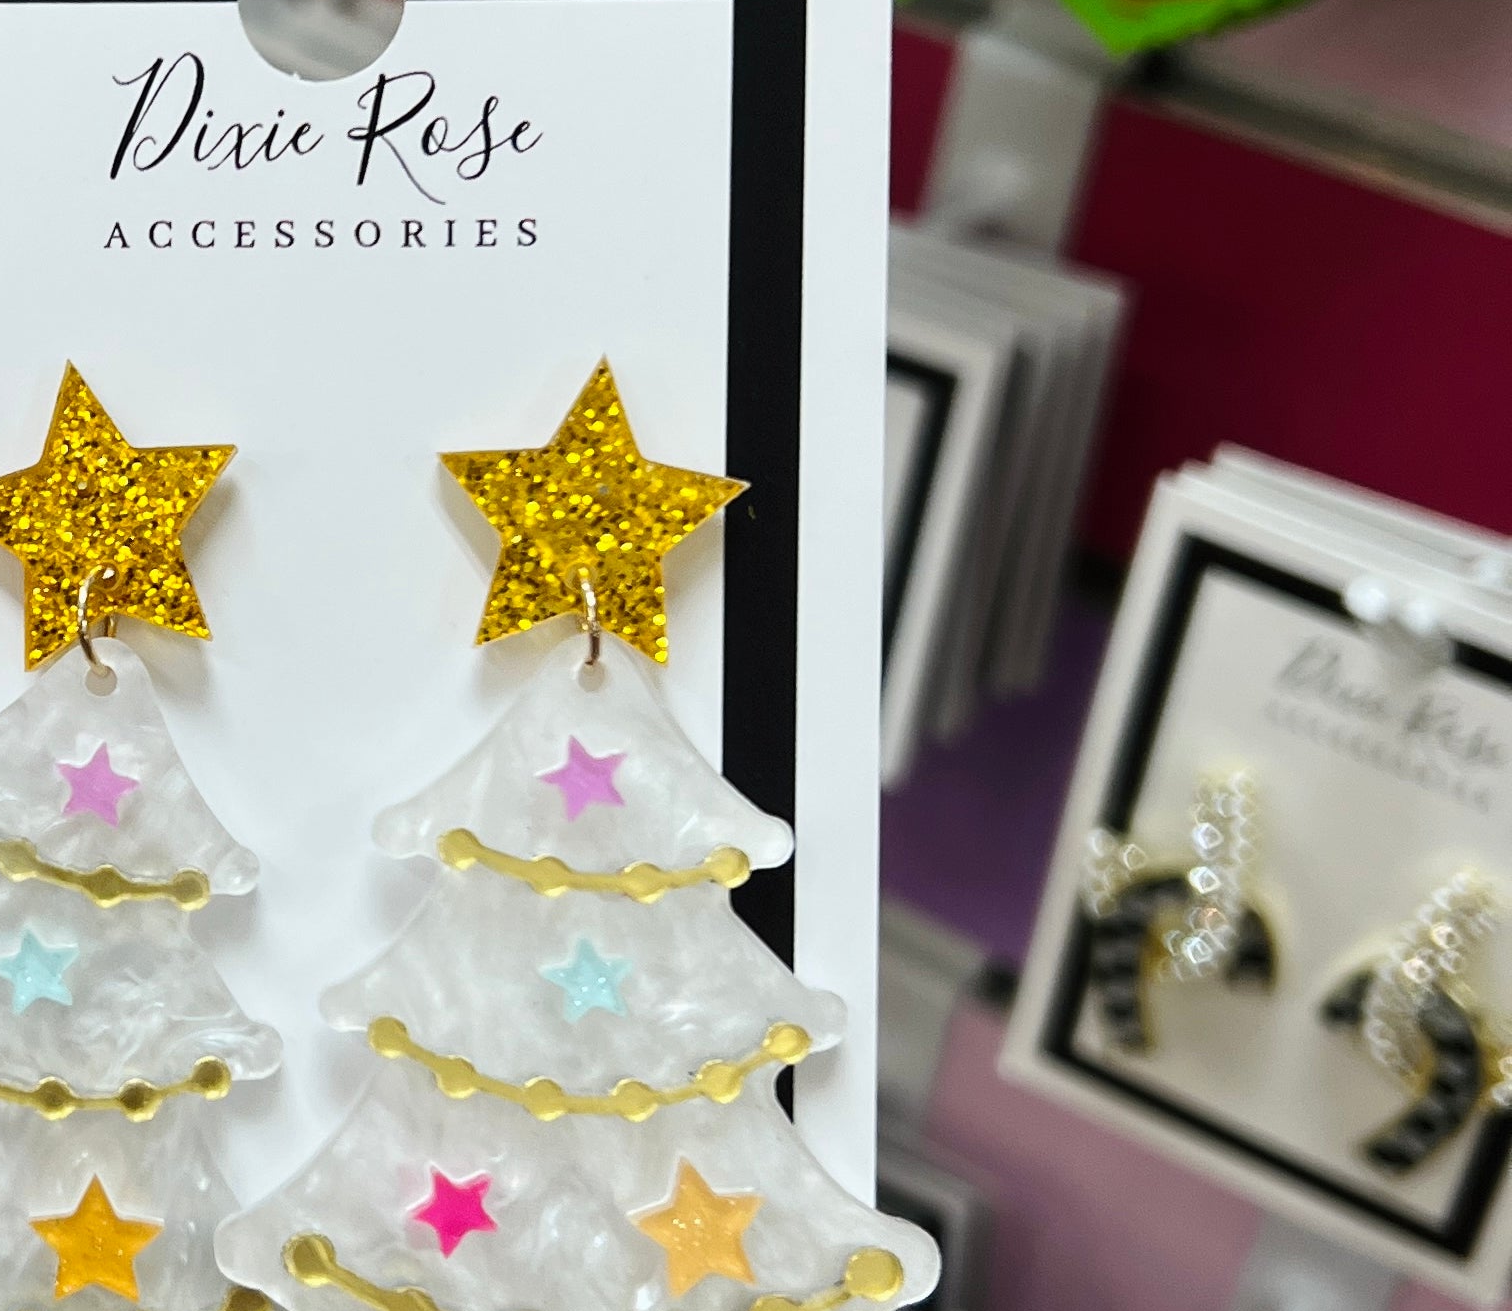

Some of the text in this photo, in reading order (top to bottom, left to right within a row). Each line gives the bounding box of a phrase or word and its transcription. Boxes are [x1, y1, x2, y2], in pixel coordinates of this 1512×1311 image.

[110, 51, 544, 206] Dixie Rose
[103, 218, 539, 250] ACCESSORIES
